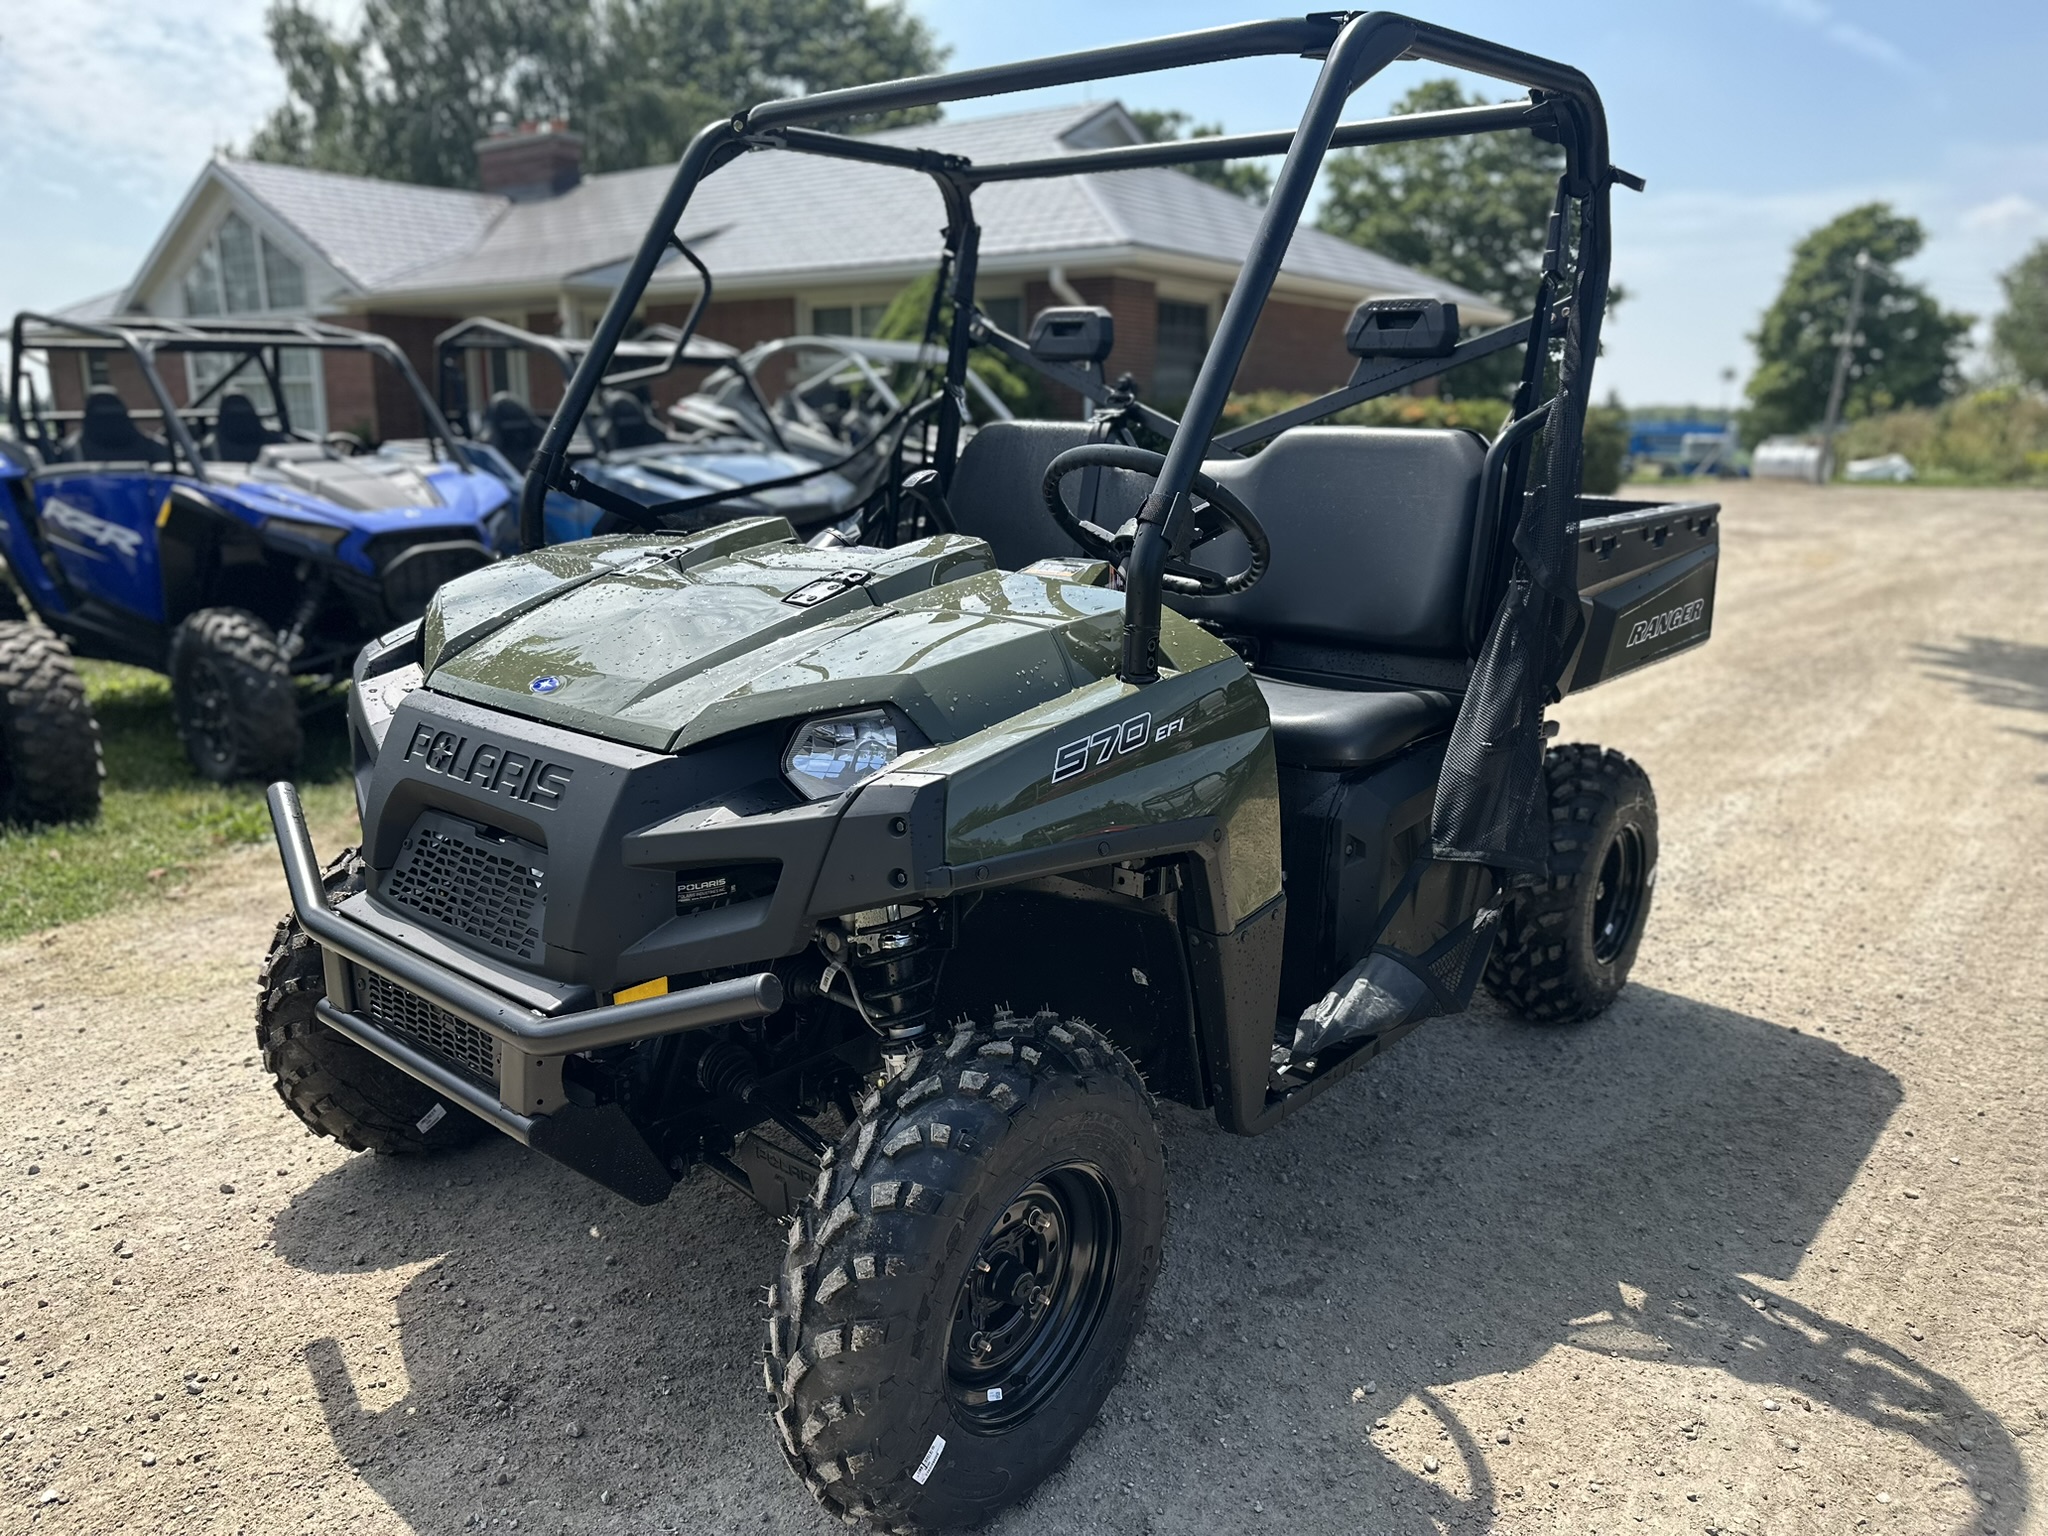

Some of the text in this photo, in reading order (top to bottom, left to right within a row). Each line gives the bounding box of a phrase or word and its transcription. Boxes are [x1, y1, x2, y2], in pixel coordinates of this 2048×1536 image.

[1626, 598, 1704, 647] RANGER
[403, 722, 574, 810] POLARIS
[1051, 711, 1184, 784] 570 EFI
[677, 878, 726, 891] POLARIS
[756, 1146, 816, 1187] POLARI
